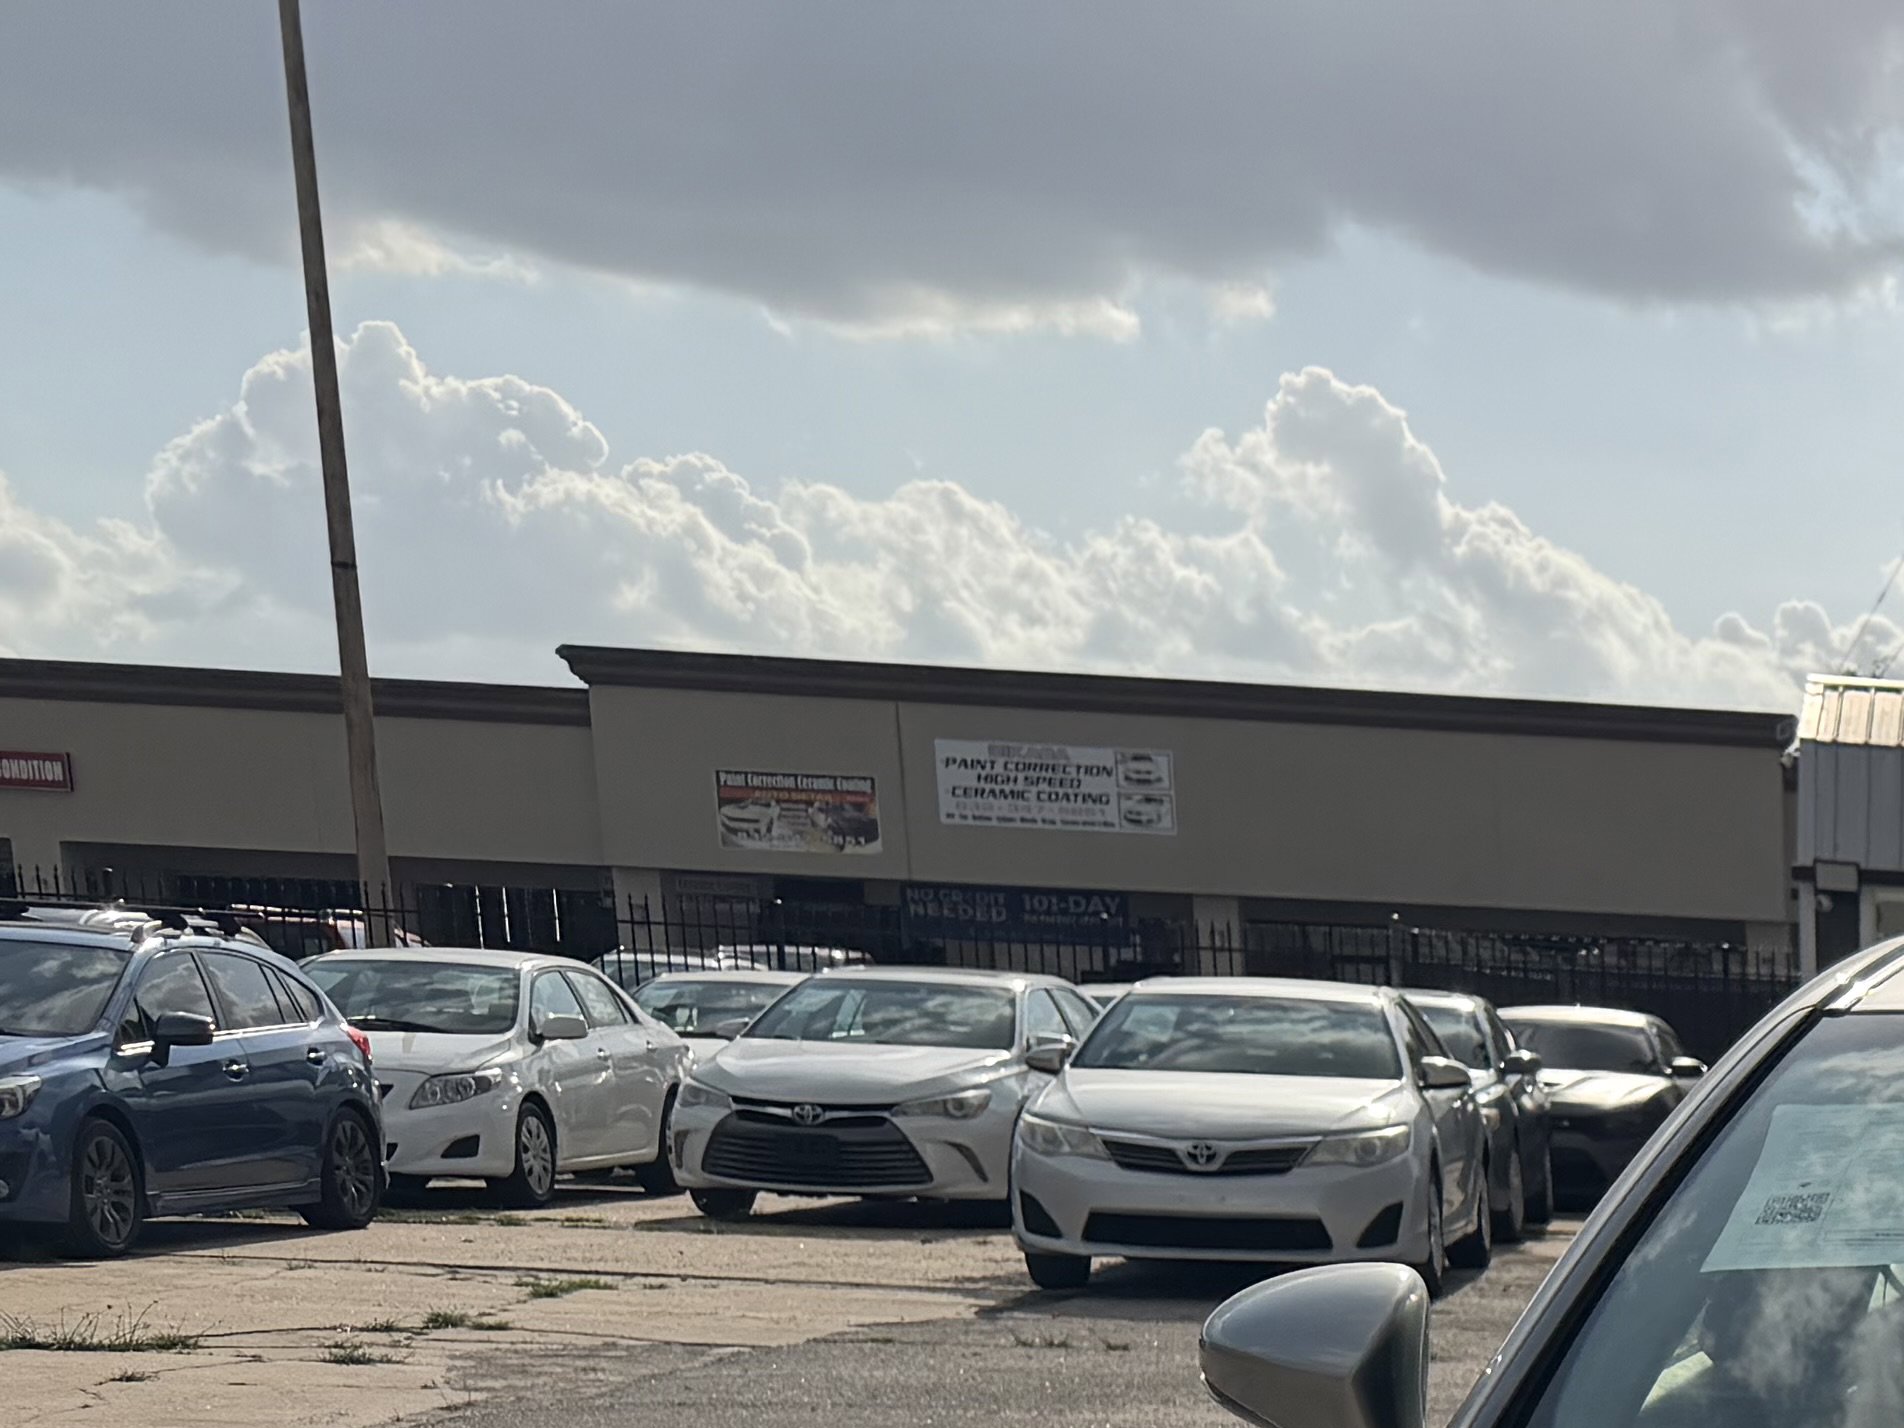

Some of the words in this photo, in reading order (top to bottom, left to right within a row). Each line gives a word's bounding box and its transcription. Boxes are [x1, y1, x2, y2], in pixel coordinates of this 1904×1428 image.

[0, 758, 63, 781] ONDITION
[944, 756, 997, 771] PAINT
[1003, 760, 1114, 778] CORRECTION
[719, 771, 746, 786] Paint
[748, 773, 796, 789] Correction
[976, 773, 1020, 786] HIGH
[1023, 775, 1082, 790] SPEED
[951, 786, 1032, 803] CERAMIC
[1036, 790, 1111, 806] COATING
[906, 888, 934, 900] NO
[909, 901, 1007, 922] NEEDED
